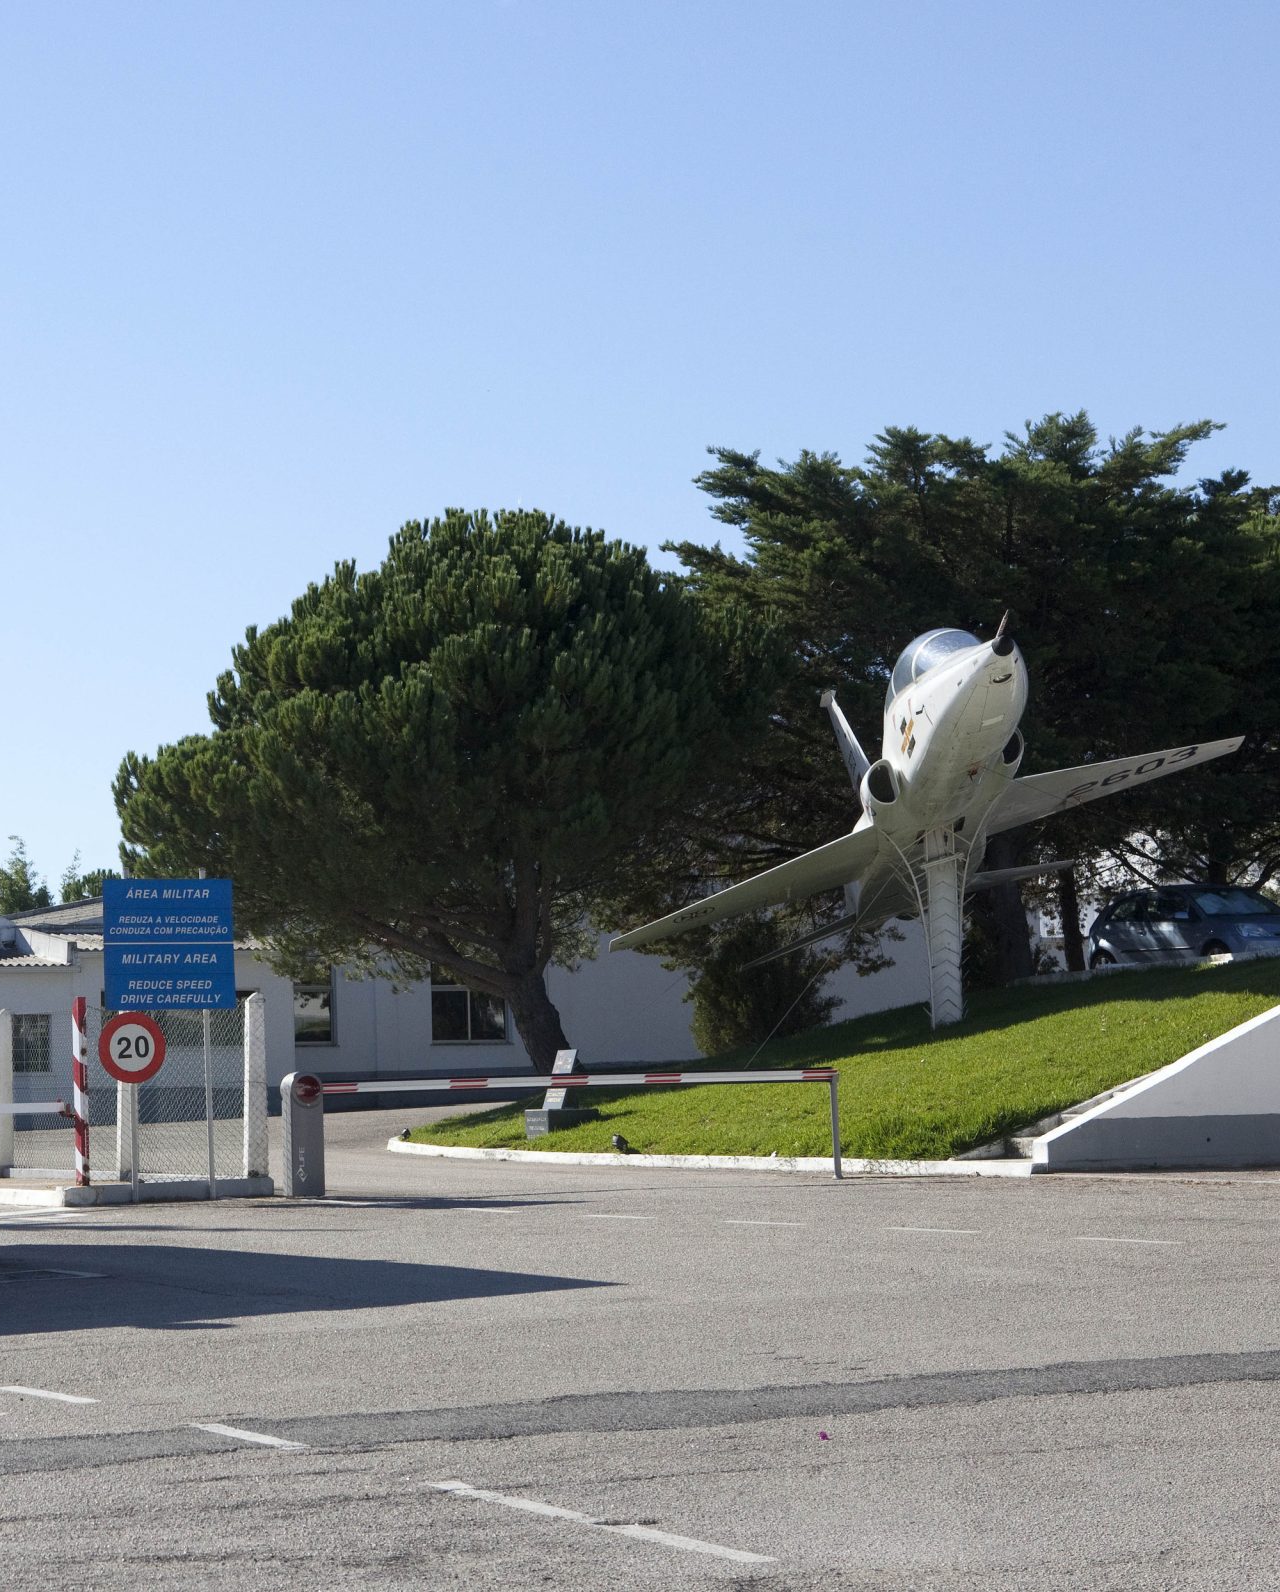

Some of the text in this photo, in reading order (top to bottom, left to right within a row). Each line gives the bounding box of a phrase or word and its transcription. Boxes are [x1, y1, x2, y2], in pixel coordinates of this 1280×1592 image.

[1066, 746, 1199, 800] 2603
[125, 887, 210, 899] ÁREA MILITAR
[118, 915, 219, 924] REDUZA A VELOCIDADE
[109, 925, 229, 936] CONDUZA COM PRECAUÇÃO
[121, 953, 218, 965] MILITARY AREA
[128, 980, 213, 990] REDUCE SPEED
[120, 994, 221, 1004] DRIVE CAREFULLY
[117, 1035, 150, 1059] 20
